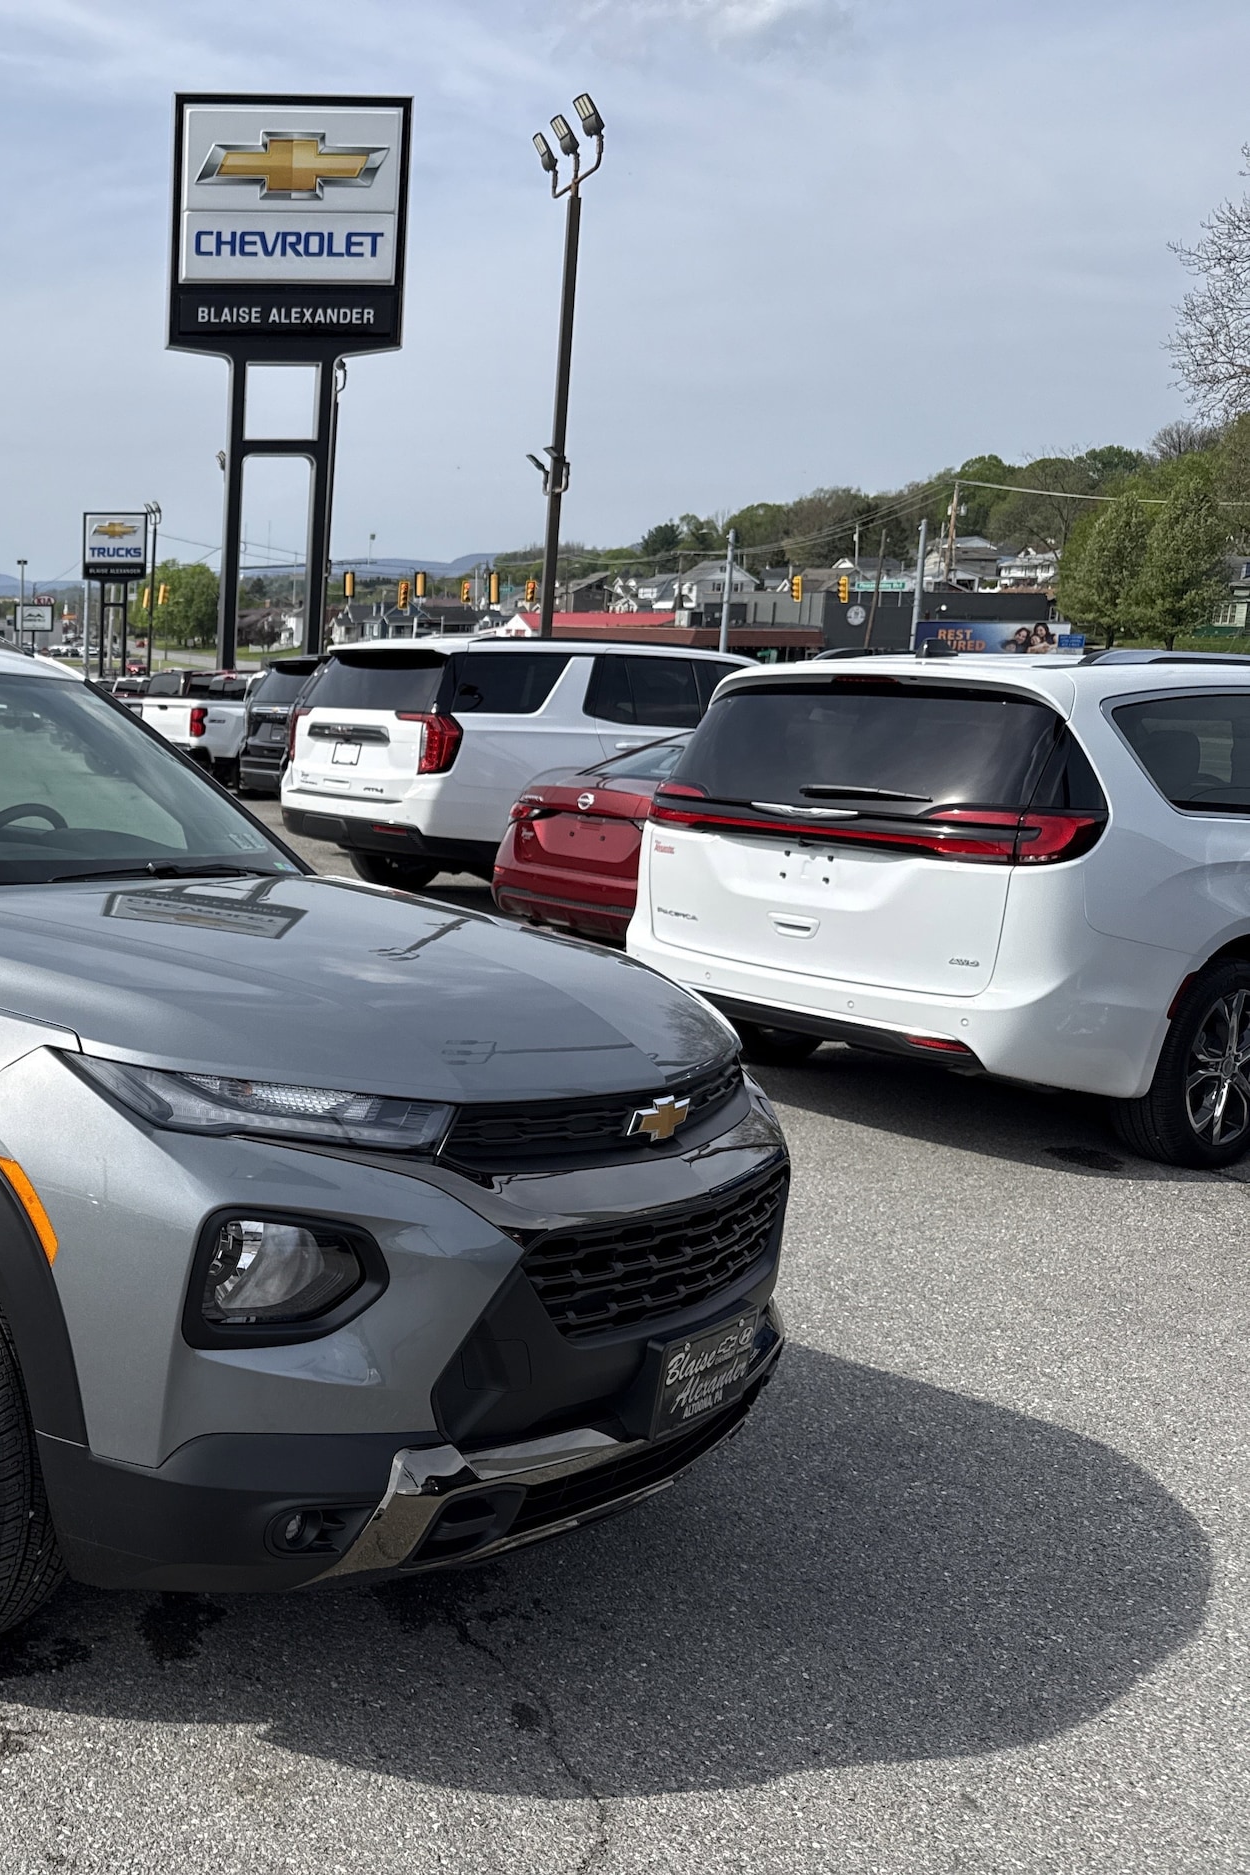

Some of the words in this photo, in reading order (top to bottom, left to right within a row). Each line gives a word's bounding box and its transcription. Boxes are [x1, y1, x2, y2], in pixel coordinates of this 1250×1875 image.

[194, 230, 385, 258] CHEVROLET
[197, 306, 261, 324] BLAISE
[268, 307, 375, 325] ALEXANDER
[89, 547, 142, 558] TRUCKS
[938, 628, 973, 640] REST
[950, 640, 986, 651] URED
[666, 1351, 718, 1386] Blaise
[669, 1356, 747, 1414] Alexander
